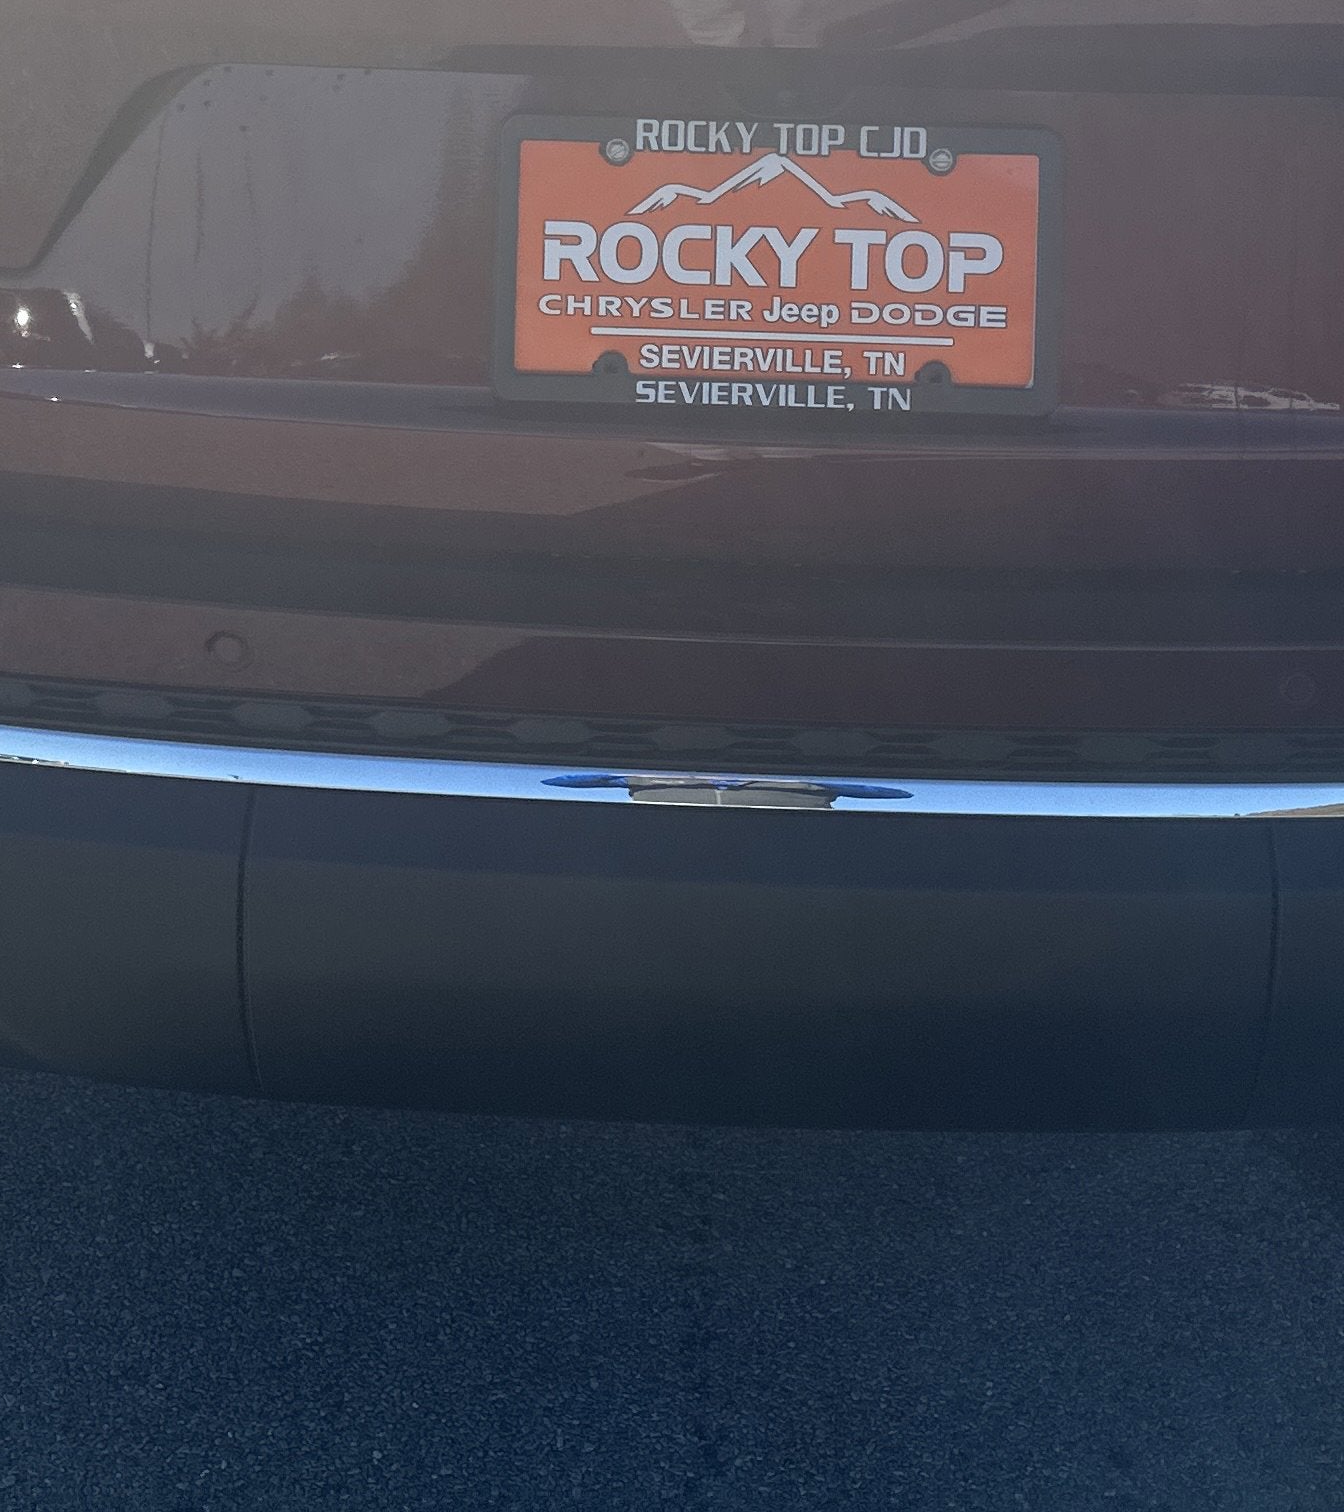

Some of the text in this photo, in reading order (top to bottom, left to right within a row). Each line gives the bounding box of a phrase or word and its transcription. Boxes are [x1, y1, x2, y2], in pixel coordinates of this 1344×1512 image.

[636, 118, 928, 160] ROCKY TOP CJD
[543, 220, 1005, 294] ROCKY TOP
[538, 294, 1008, 329] CHRYSLER Jeep DODGE
[639, 343, 907, 379] SEVIERVILLE, TN
[635, 380, 912, 413] SEVIERVILLE, TN
